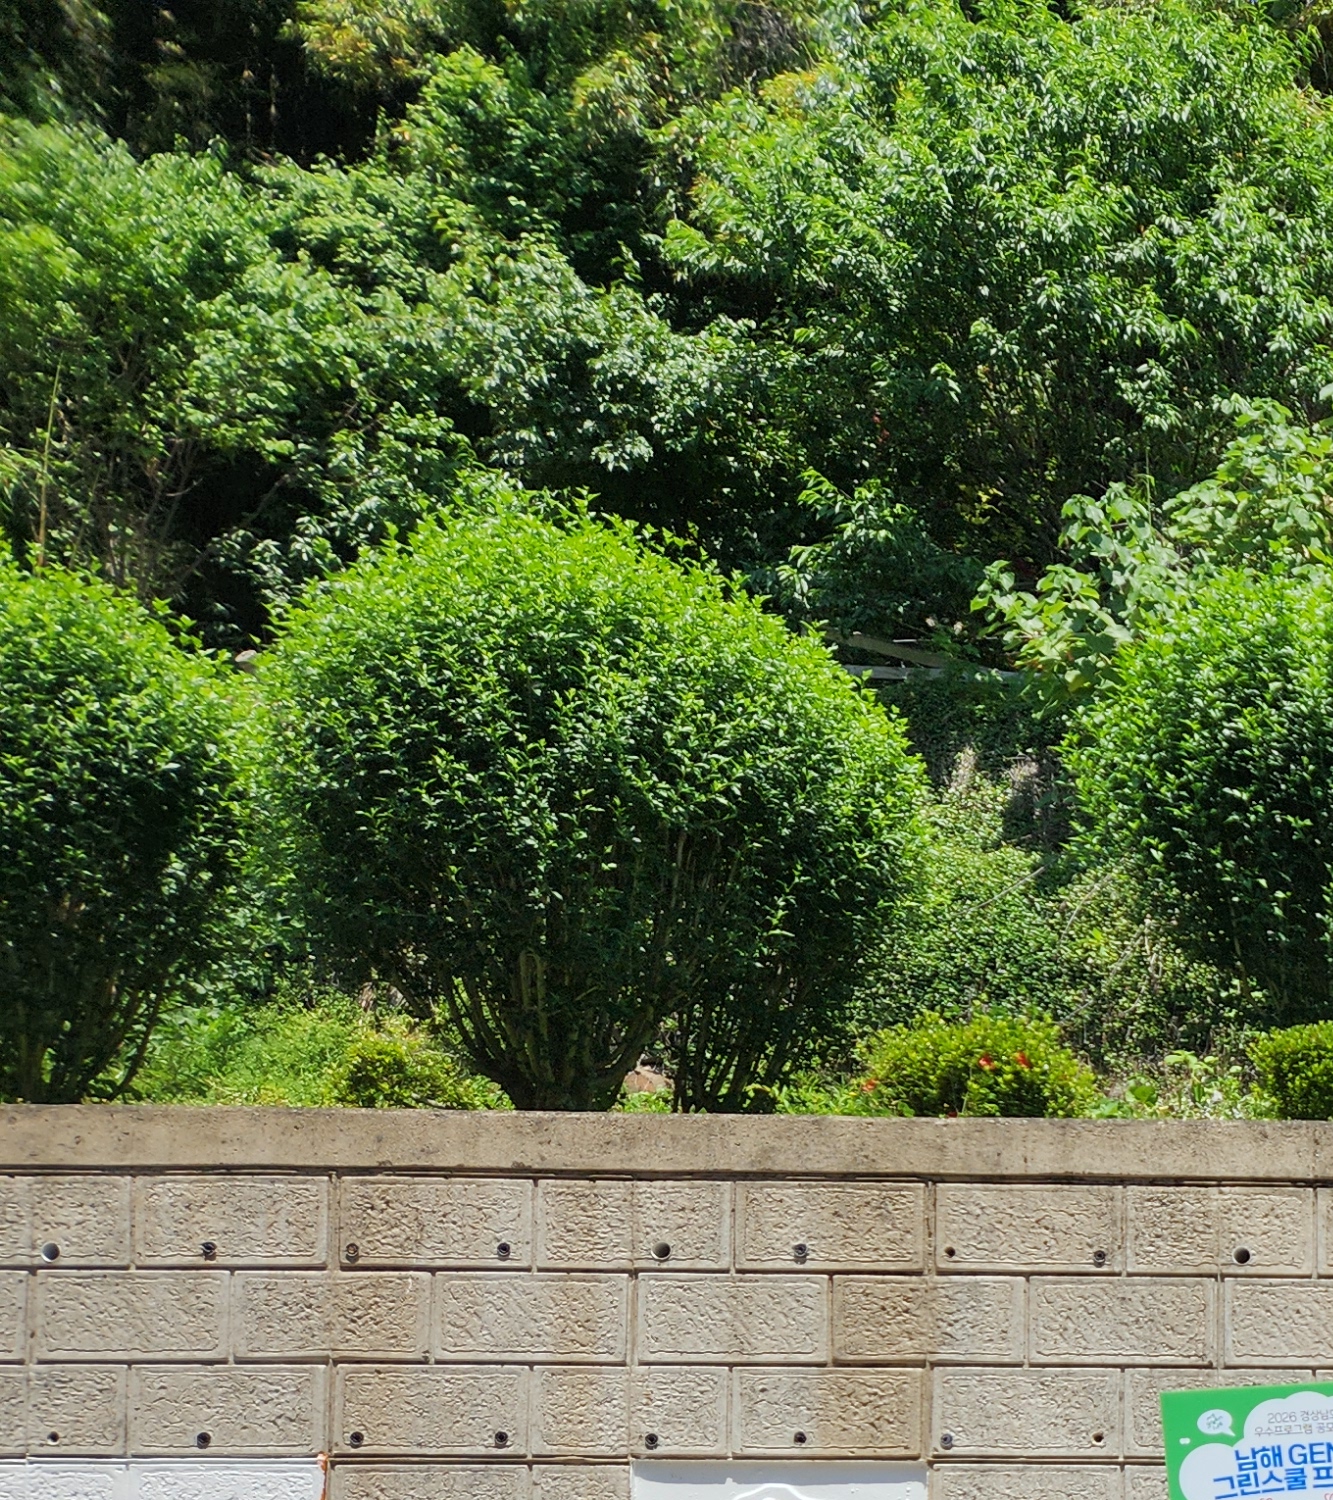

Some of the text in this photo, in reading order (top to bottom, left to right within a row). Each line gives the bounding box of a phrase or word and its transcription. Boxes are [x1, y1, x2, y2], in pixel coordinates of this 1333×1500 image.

[1267, 1411, 1297, 1424] 2026
[1254, 1424, 1313, 1438] 우수프로그램
[1234, 1444, 1283, 1472] 남해
[1213, 1468, 1307, 1500] 그린스쿨
